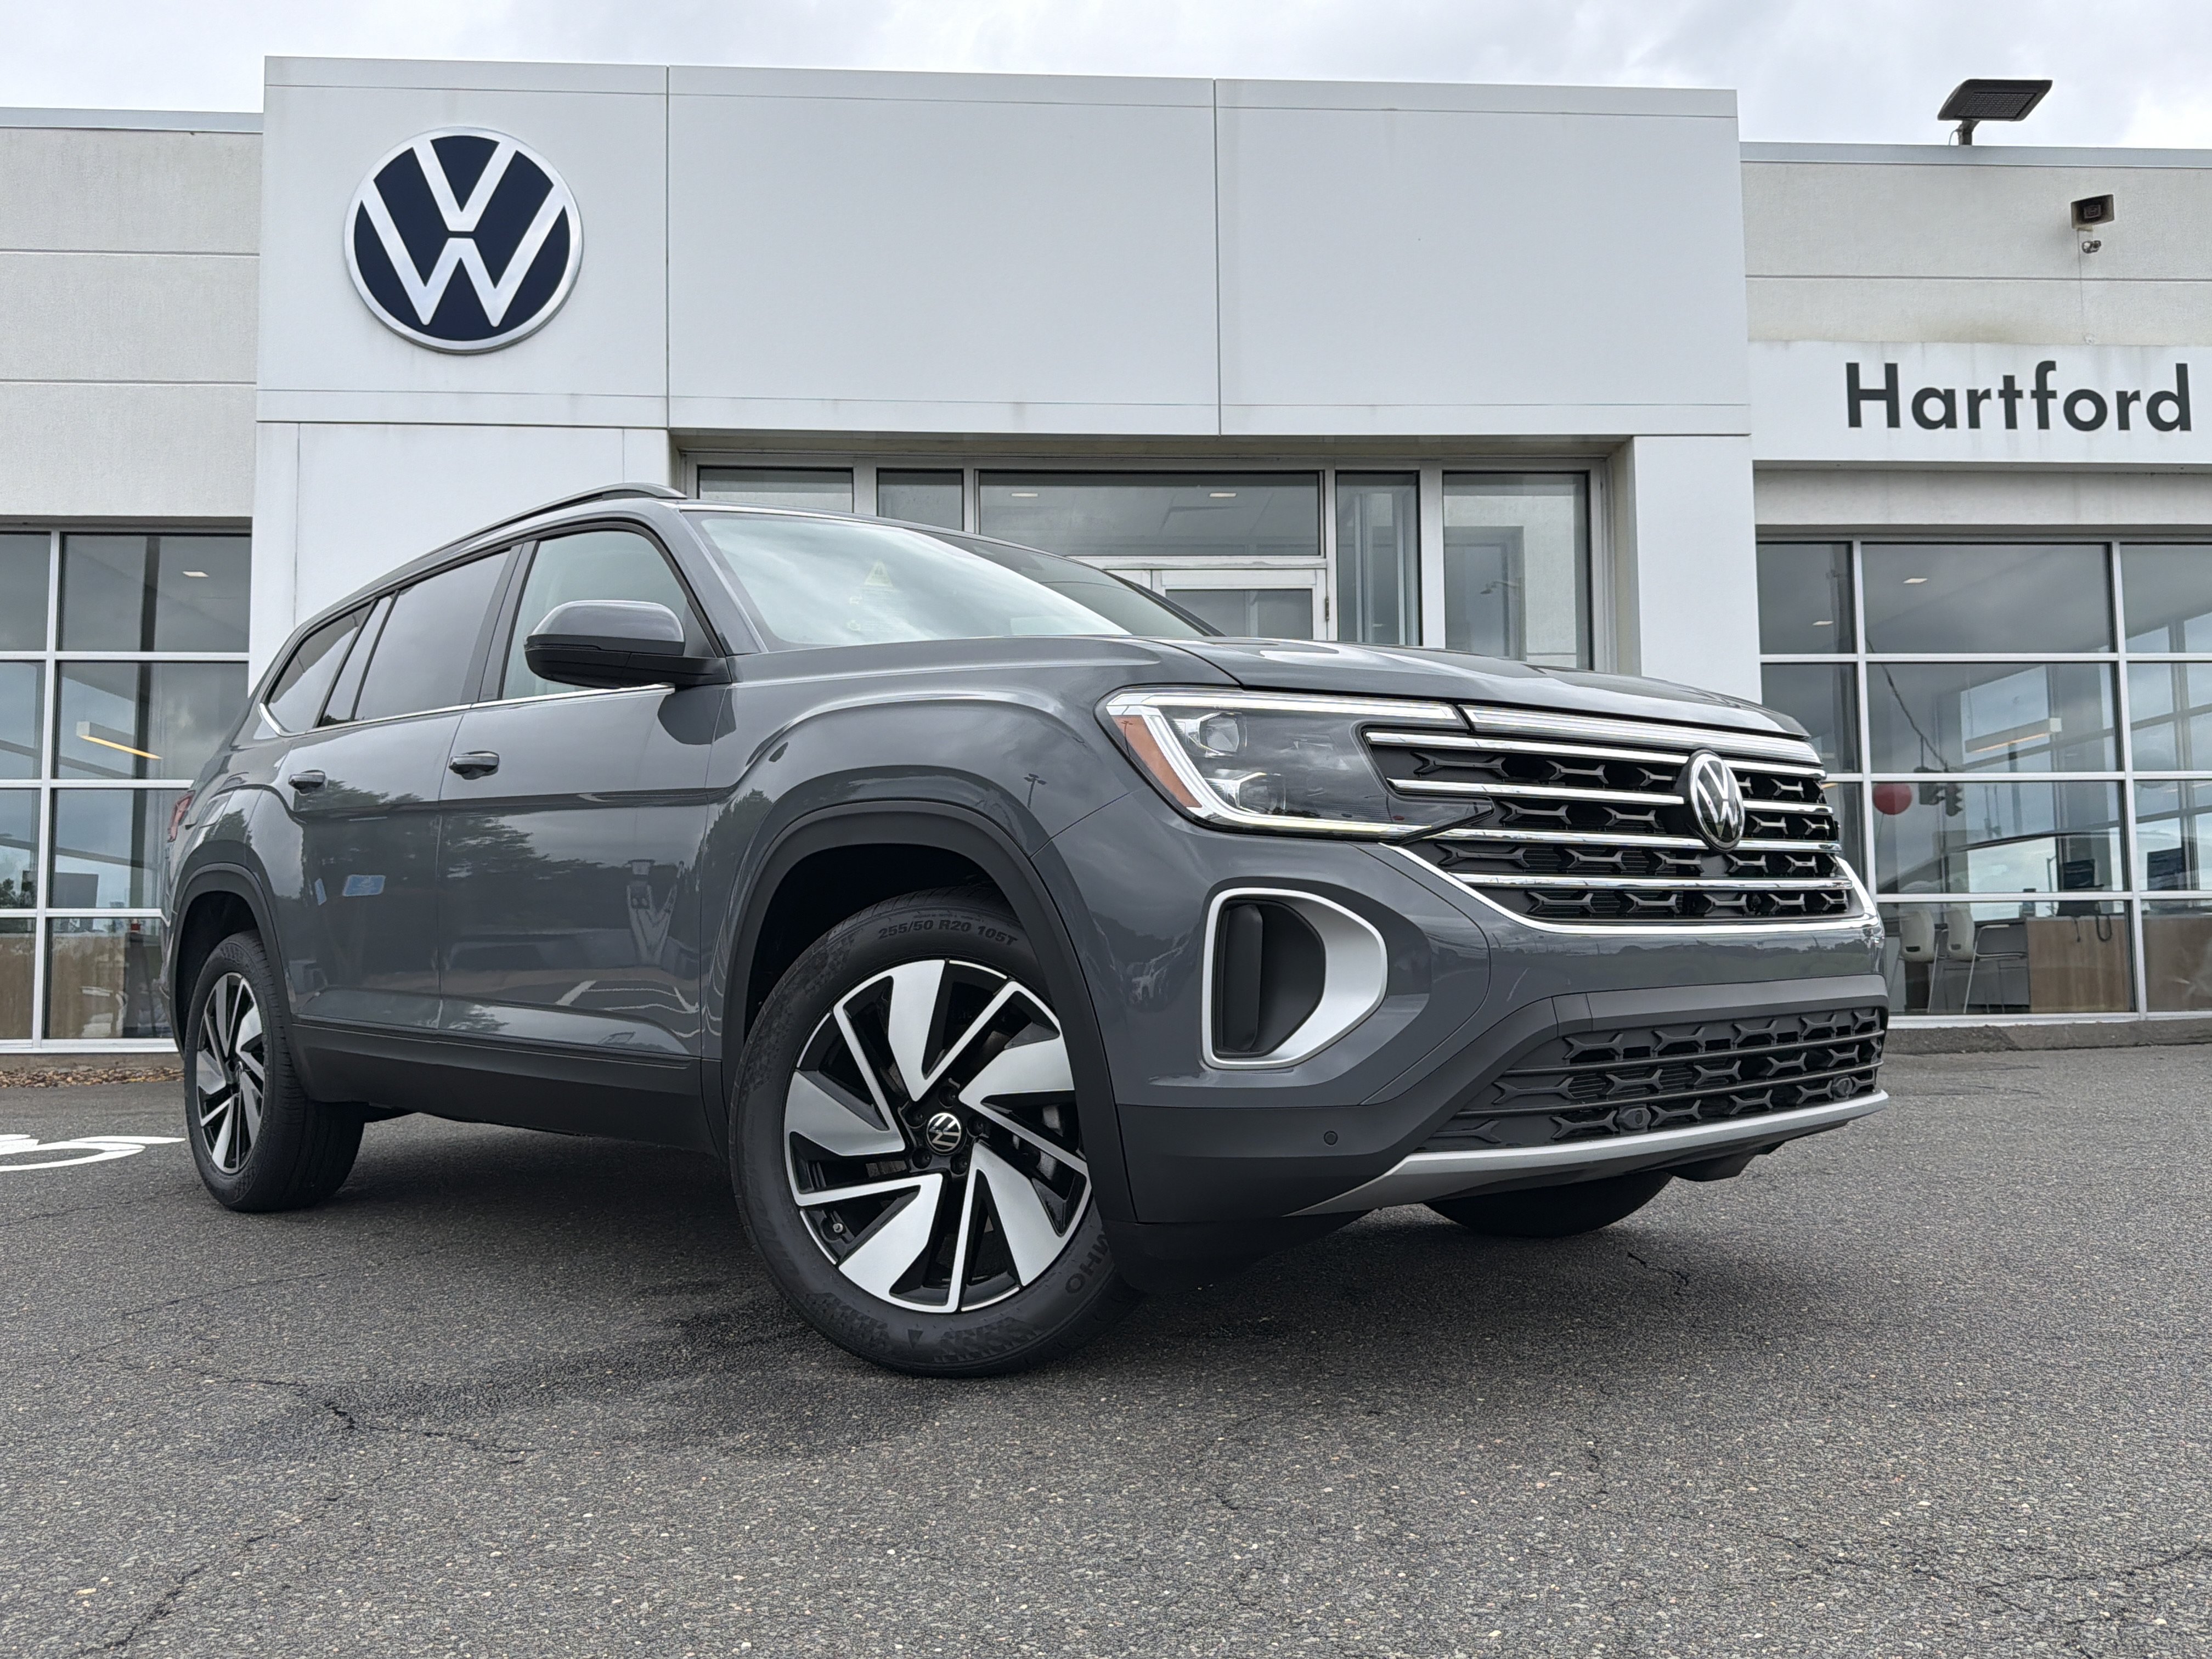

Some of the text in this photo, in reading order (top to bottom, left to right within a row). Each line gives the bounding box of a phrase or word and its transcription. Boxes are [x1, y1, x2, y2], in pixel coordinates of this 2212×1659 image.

[350, 129, 577, 335] VW
[1846, 360, 2192, 432] Hartford
[1692, 755, 1743, 845] VW
[878, 919, 1018, 946] 255/50 R20 105T
